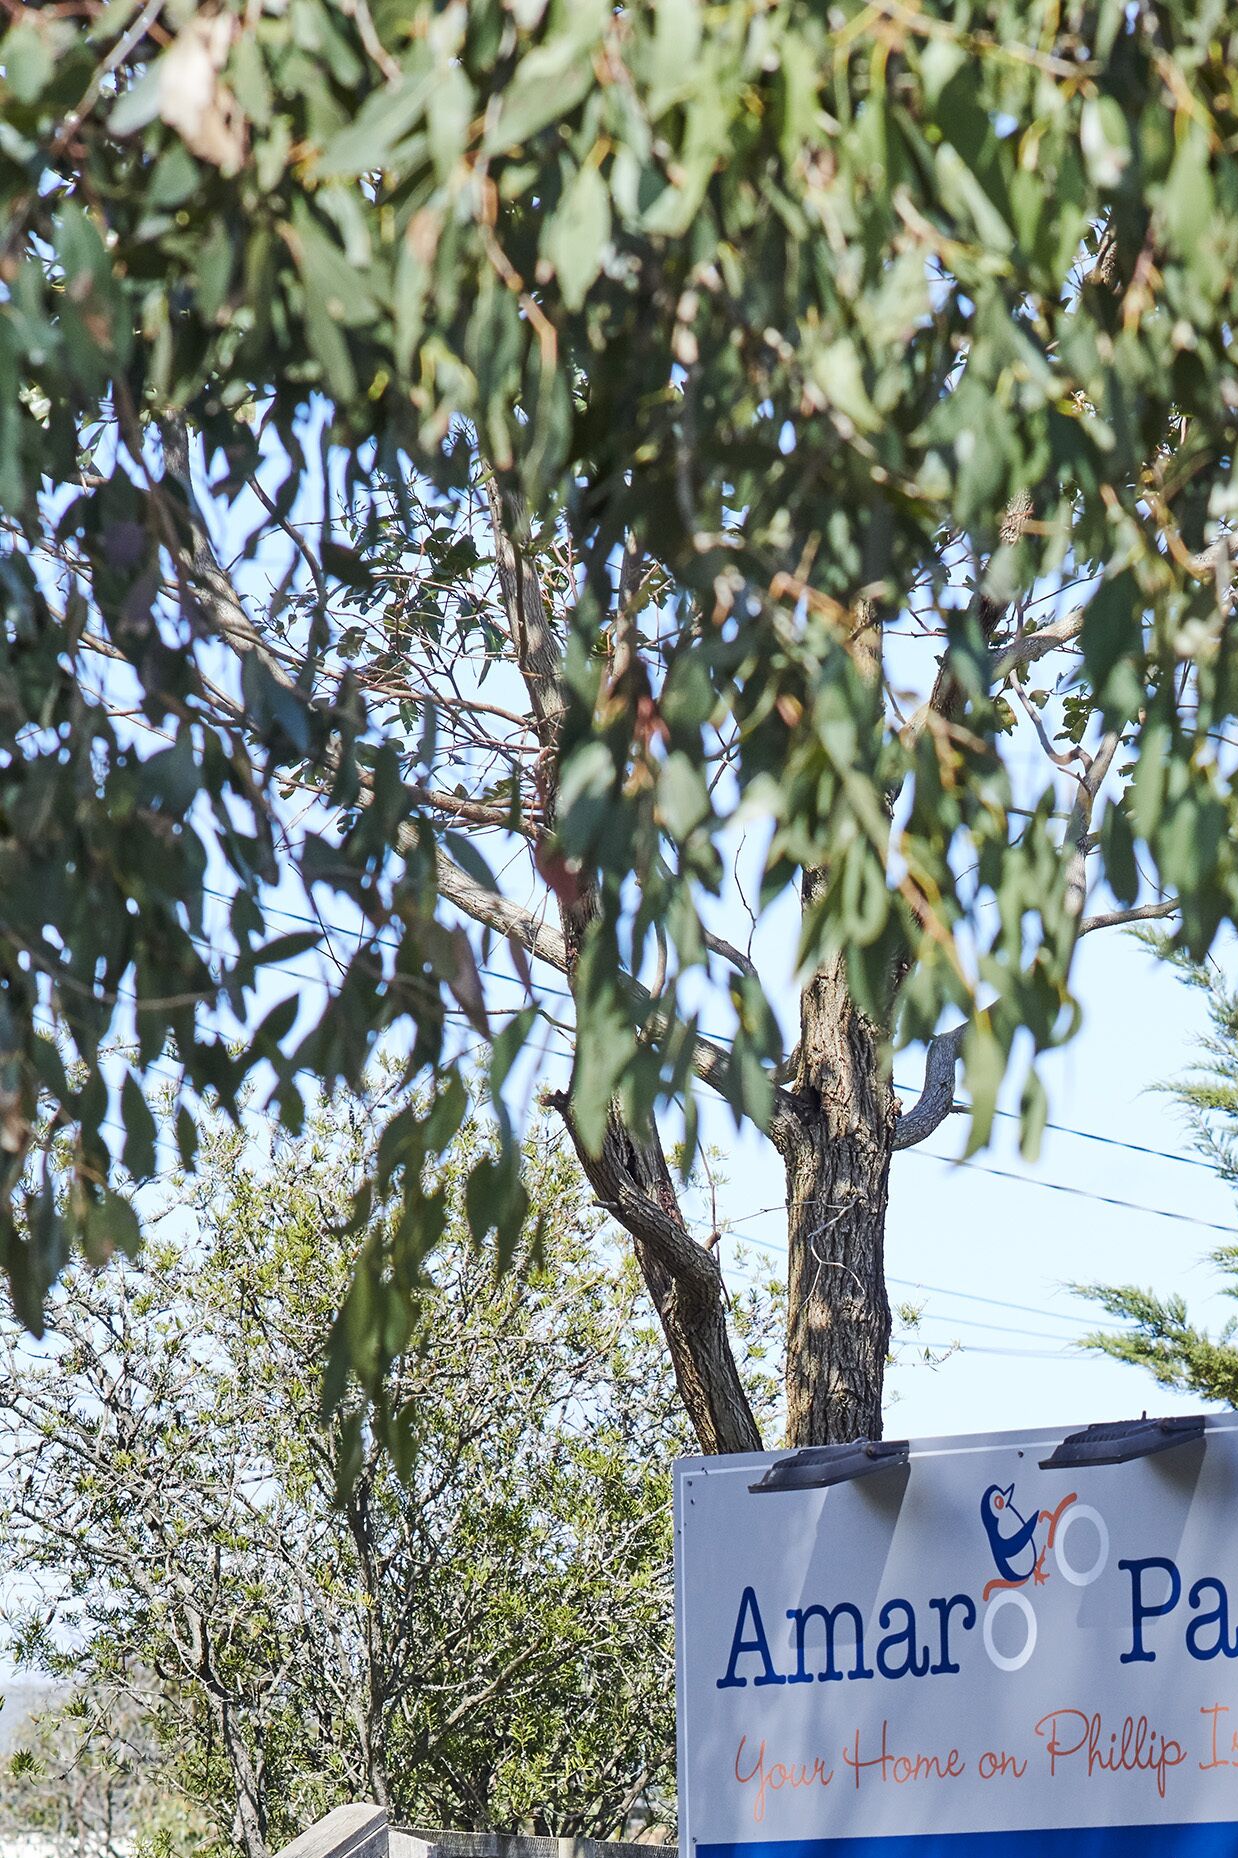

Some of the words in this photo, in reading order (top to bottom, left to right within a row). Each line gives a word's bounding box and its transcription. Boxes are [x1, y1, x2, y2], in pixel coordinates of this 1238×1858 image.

[734, 1733, 834, 1822] Your
[841, 1718, 966, 1789] Home
[978, 1743, 1027, 1779] on
[1034, 1707, 1187, 1798] Phillip
